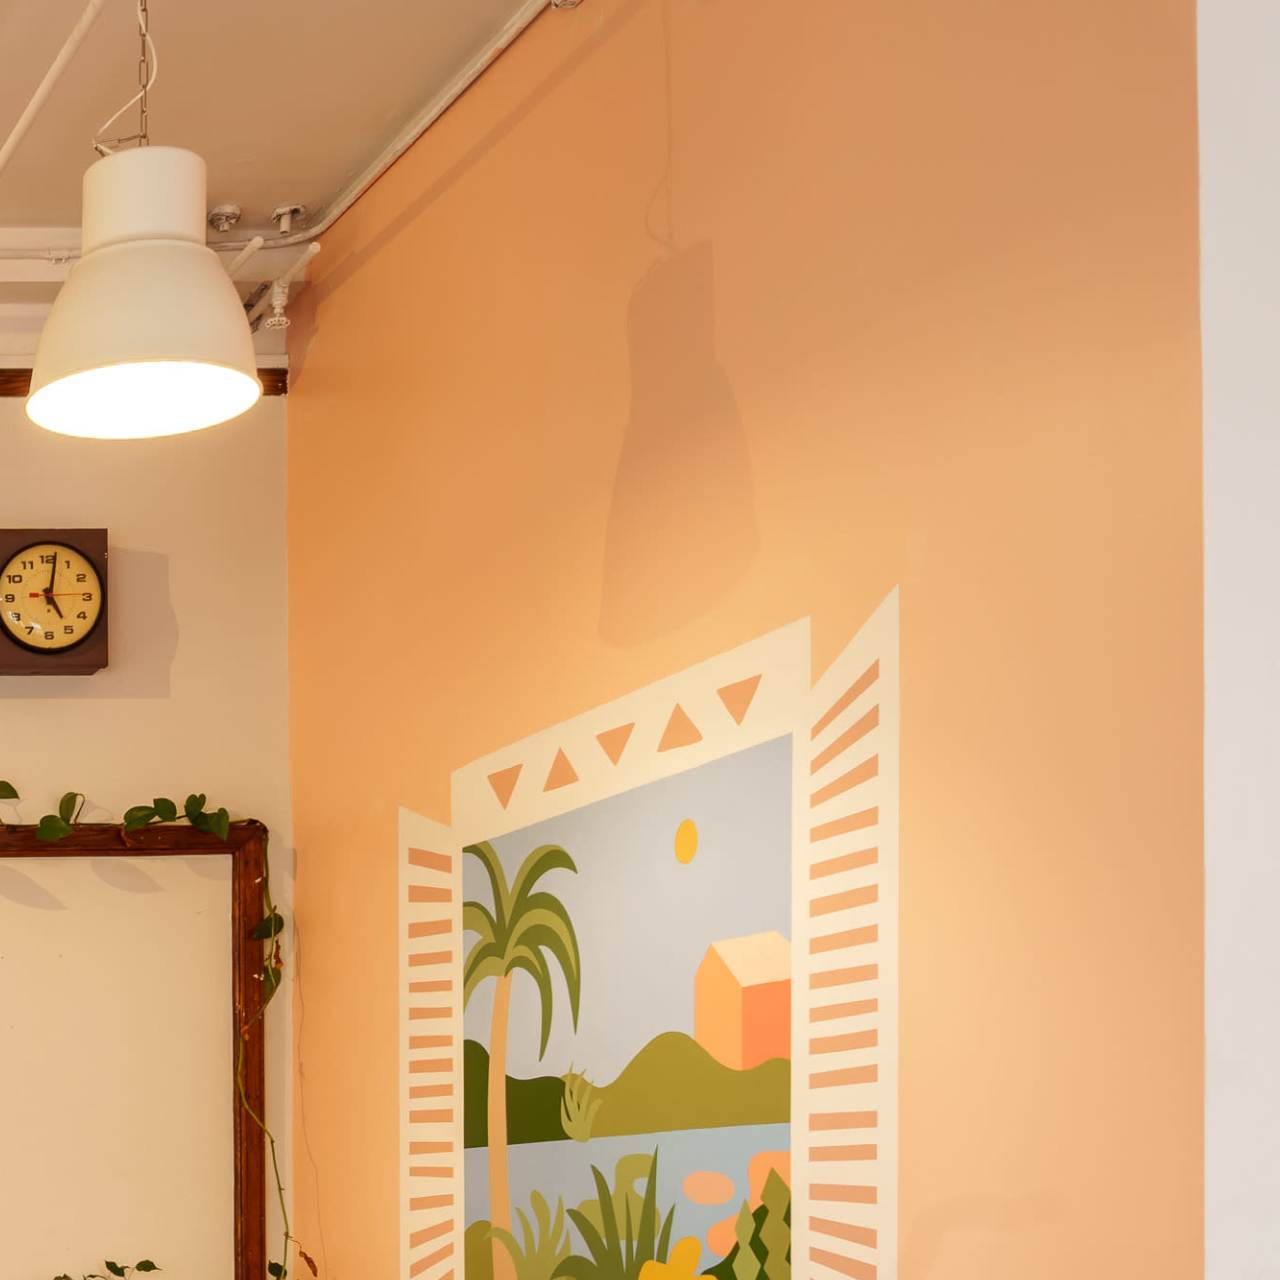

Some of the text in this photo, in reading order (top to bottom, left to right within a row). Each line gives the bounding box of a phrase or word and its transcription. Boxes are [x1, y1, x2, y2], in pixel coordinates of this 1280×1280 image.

[39, 555, 56, 564] 12
[21, 561, 34, 570] 11
[64, 561, 70, 569] 1
[6, 574, 22, 584] 10
[76, 573, 87, 582] 2
[4, 594, 15, 603] 9
[82, 593, 92, 602] 3
[76, 611, 87, 620] 4
[25, 626, 34, 635] 7
[63, 626, 74, 635] 5
[44, 631, 54, 640] 6
